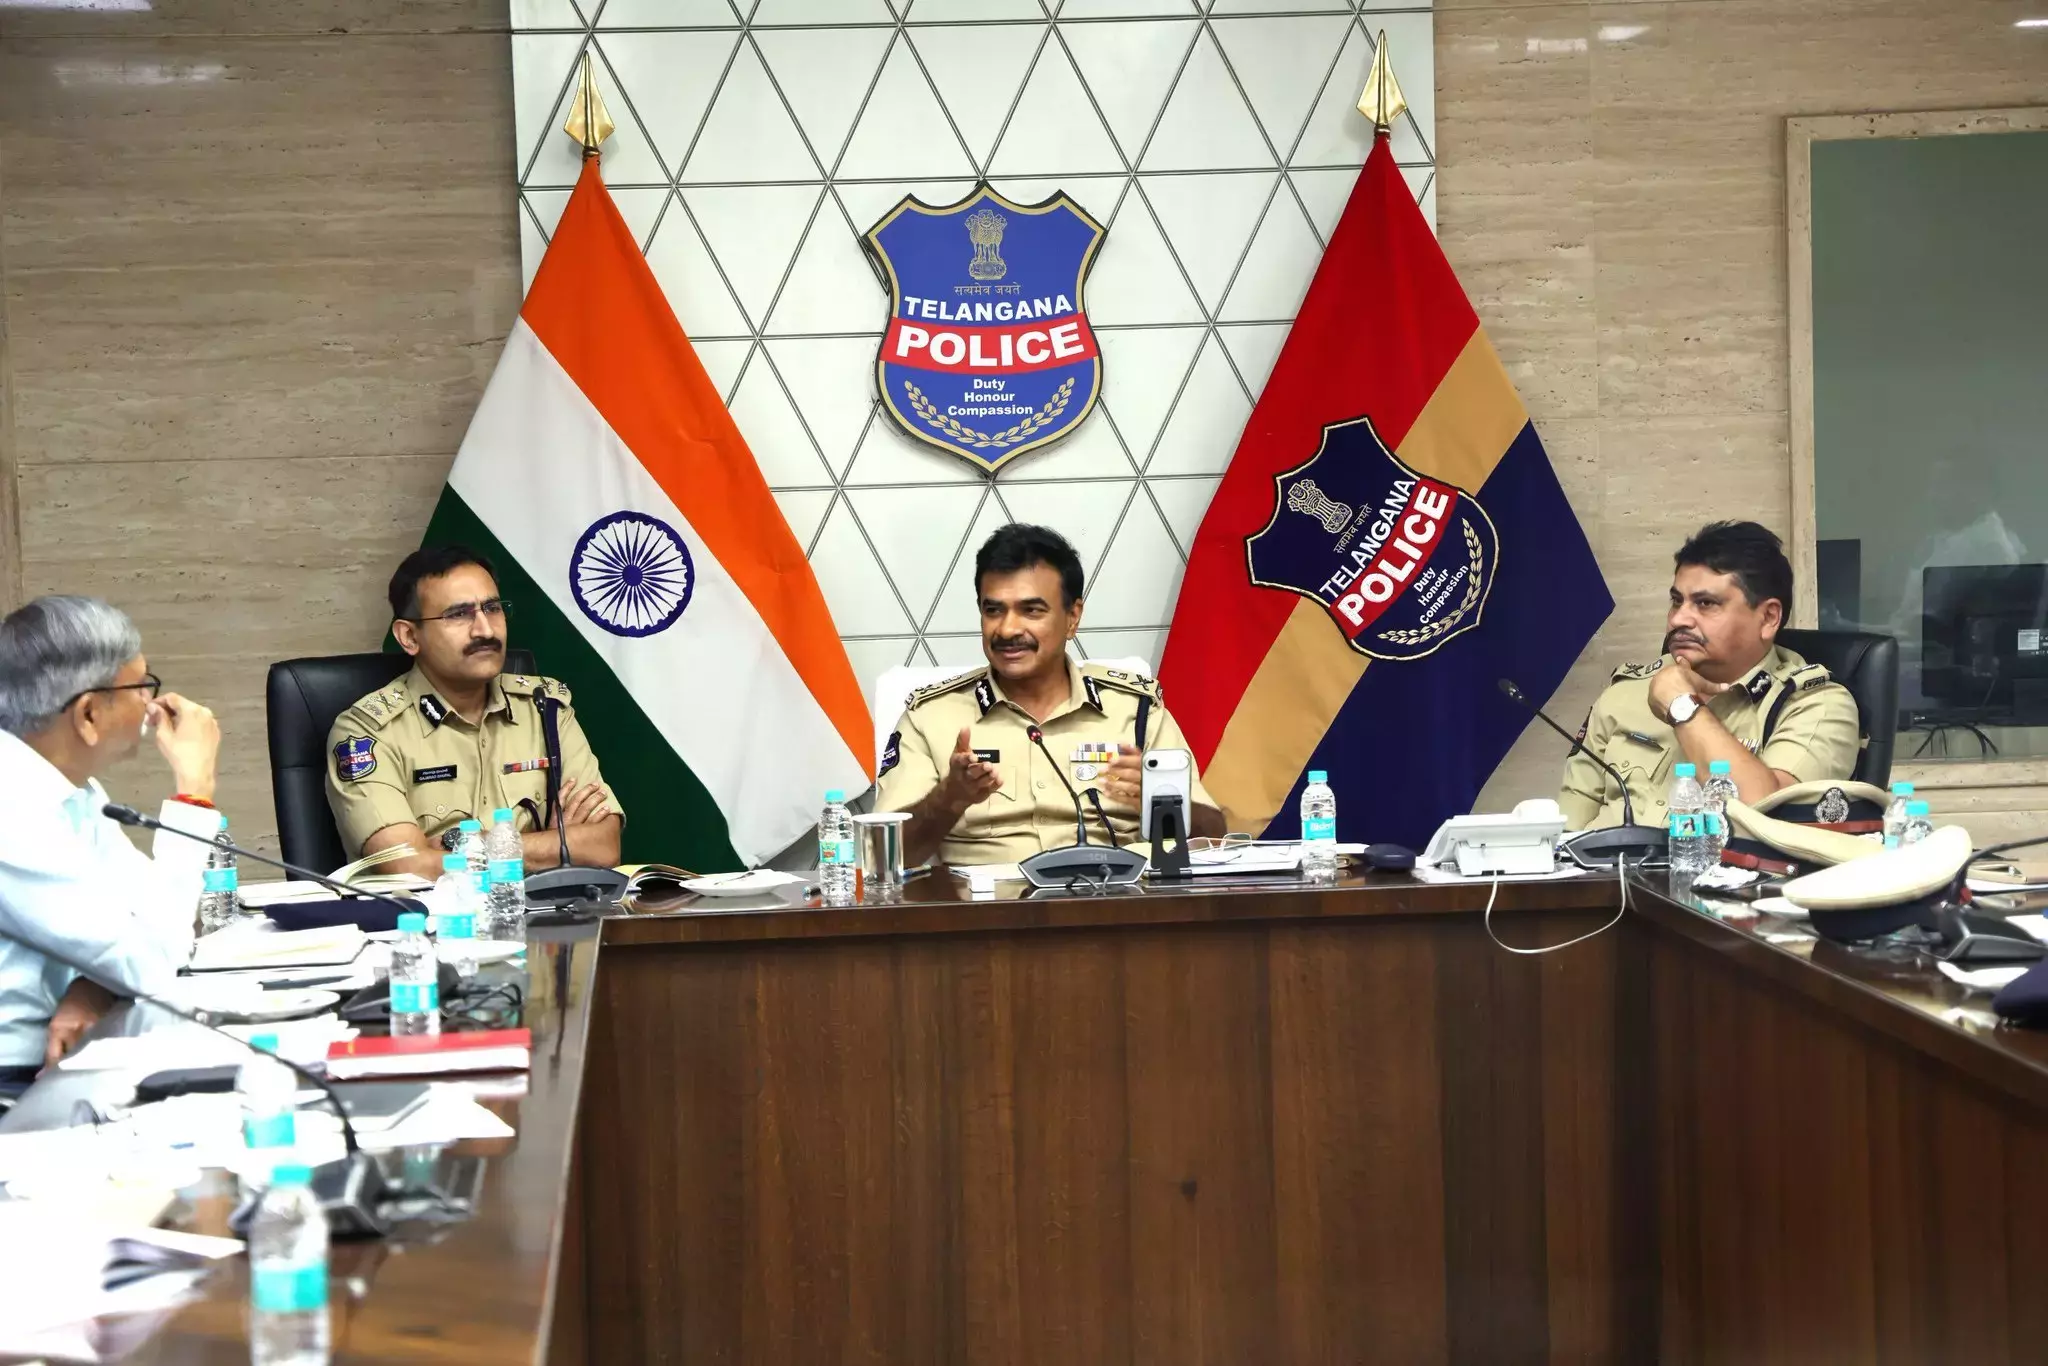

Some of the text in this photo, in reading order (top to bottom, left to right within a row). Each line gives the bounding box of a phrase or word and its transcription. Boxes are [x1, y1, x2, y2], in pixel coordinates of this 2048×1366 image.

[954, 281, 1021, 296] सत्यमेव जयते
[904, 294, 1073, 322] TELANGANA
[896, 322, 1085, 367] POLICE
[964, 392, 1015, 403] Honour
[973, 378, 1006, 391] Duty
[947, 405, 1033, 418] Compassion
[1354, 503, 1373, 526] जयते
[1319, 478, 1416, 601] TELANGANA
[1337, 486, 1449, 627] POLICE
[1413, 567, 1436, 593] Duty
[1418, 568, 1449, 607] Honour
[1419, 564, 1469, 624] Compassion
